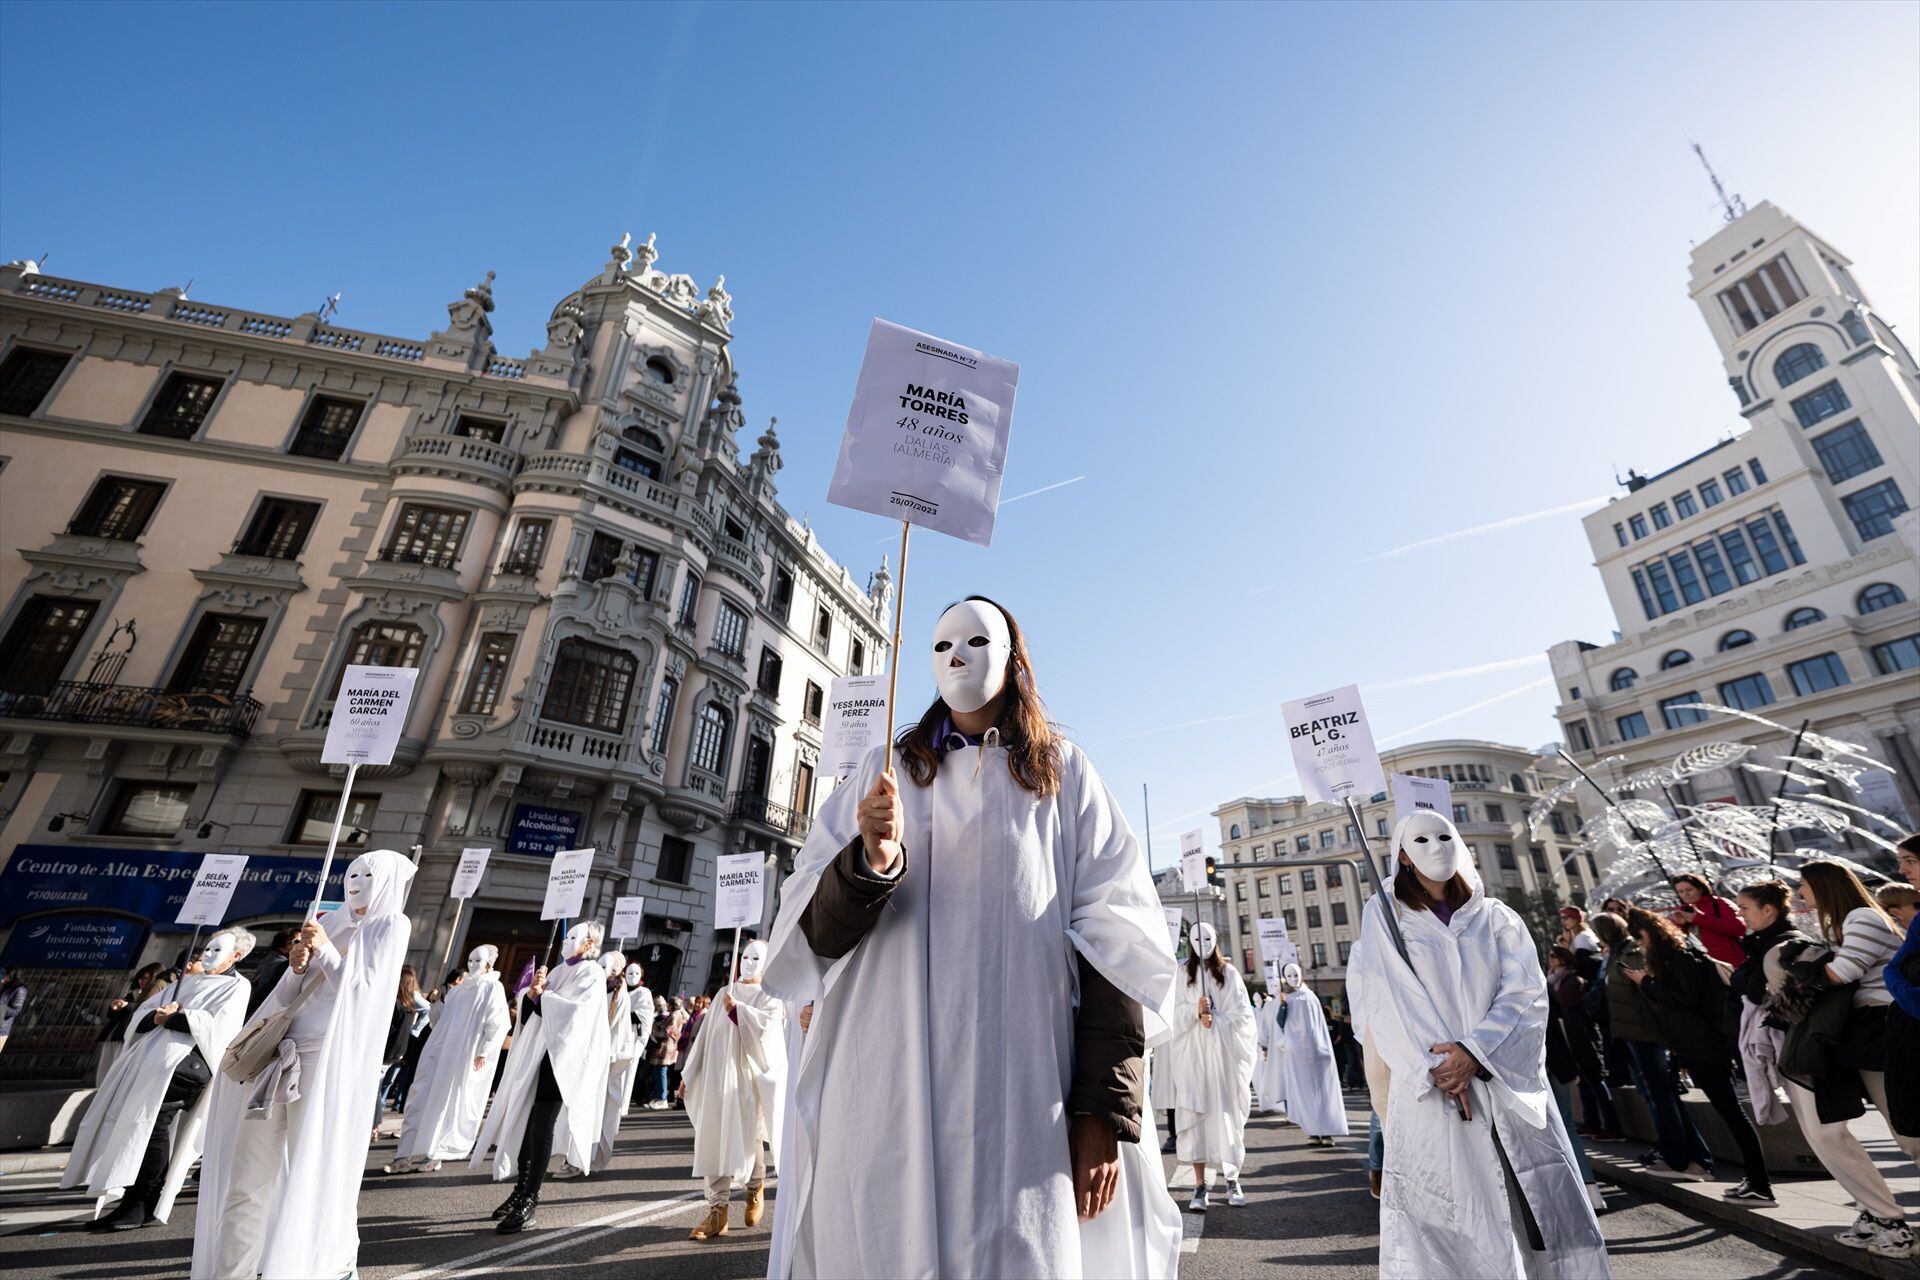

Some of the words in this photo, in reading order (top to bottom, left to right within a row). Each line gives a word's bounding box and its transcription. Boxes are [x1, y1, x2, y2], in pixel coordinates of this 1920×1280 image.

[916, 342, 959, 359] ASESINADA
[906, 383, 966, 410] MARÍA
[899, 395, 969, 425] TORRES
[896, 416, 919, 431] 48
[922, 423, 964, 444] años
[905, 434, 949, 455] DALÍAS
[893, 445, 955, 468] (ALMERÍA)
[890, 496, 938, 515] 25/07/2023
[347, 688, 379, 697] MARÍA
[381, 690, 401, 698] DEL
[350, 698, 393, 707] CARMEN
[832, 701, 853, 709] YESS
[854, 697, 885, 707] MARÍA
[842, 707, 870, 717] PÉREZ
[1290, 711, 1359, 739] BEATRIZ
[1312, 734, 1325, 746] L.
[1328, 729, 1345, 740] G.
[1328, 744, 1349, 754] años
[1415, 801, 1434, 809] NINA
[528, 811, 557, 822] Unidad
[560, 816, 570, 824] de
[518, 819, 575, 833] Alcoholismo
[517, 841, 526, 849] 91
[529, 842, 542, 850] 521
[544, 844, 554, 852] 40
[17, 858, 78, 873] Centro
[80, 864, 98, 875] de
[100, 862, 138, 877] Alta
[275, 874, 291, 883] en
[205, 872, 229, 880] BELÉN
[720, 871, 743, 880] MARÍA
[720, 878, 751, 887] CARMEN
[26, 890, 88, 901] PSIQUIATRÍA
[64, 922, 116, 932] Fundación
[46, 934, 89, 944] Instituto
[91, 936, 124, 946] Spiral
[46, 951, 66, 960] 915
[68, 952, 87, 960] 000
[88, 952, 108, 960] 050
